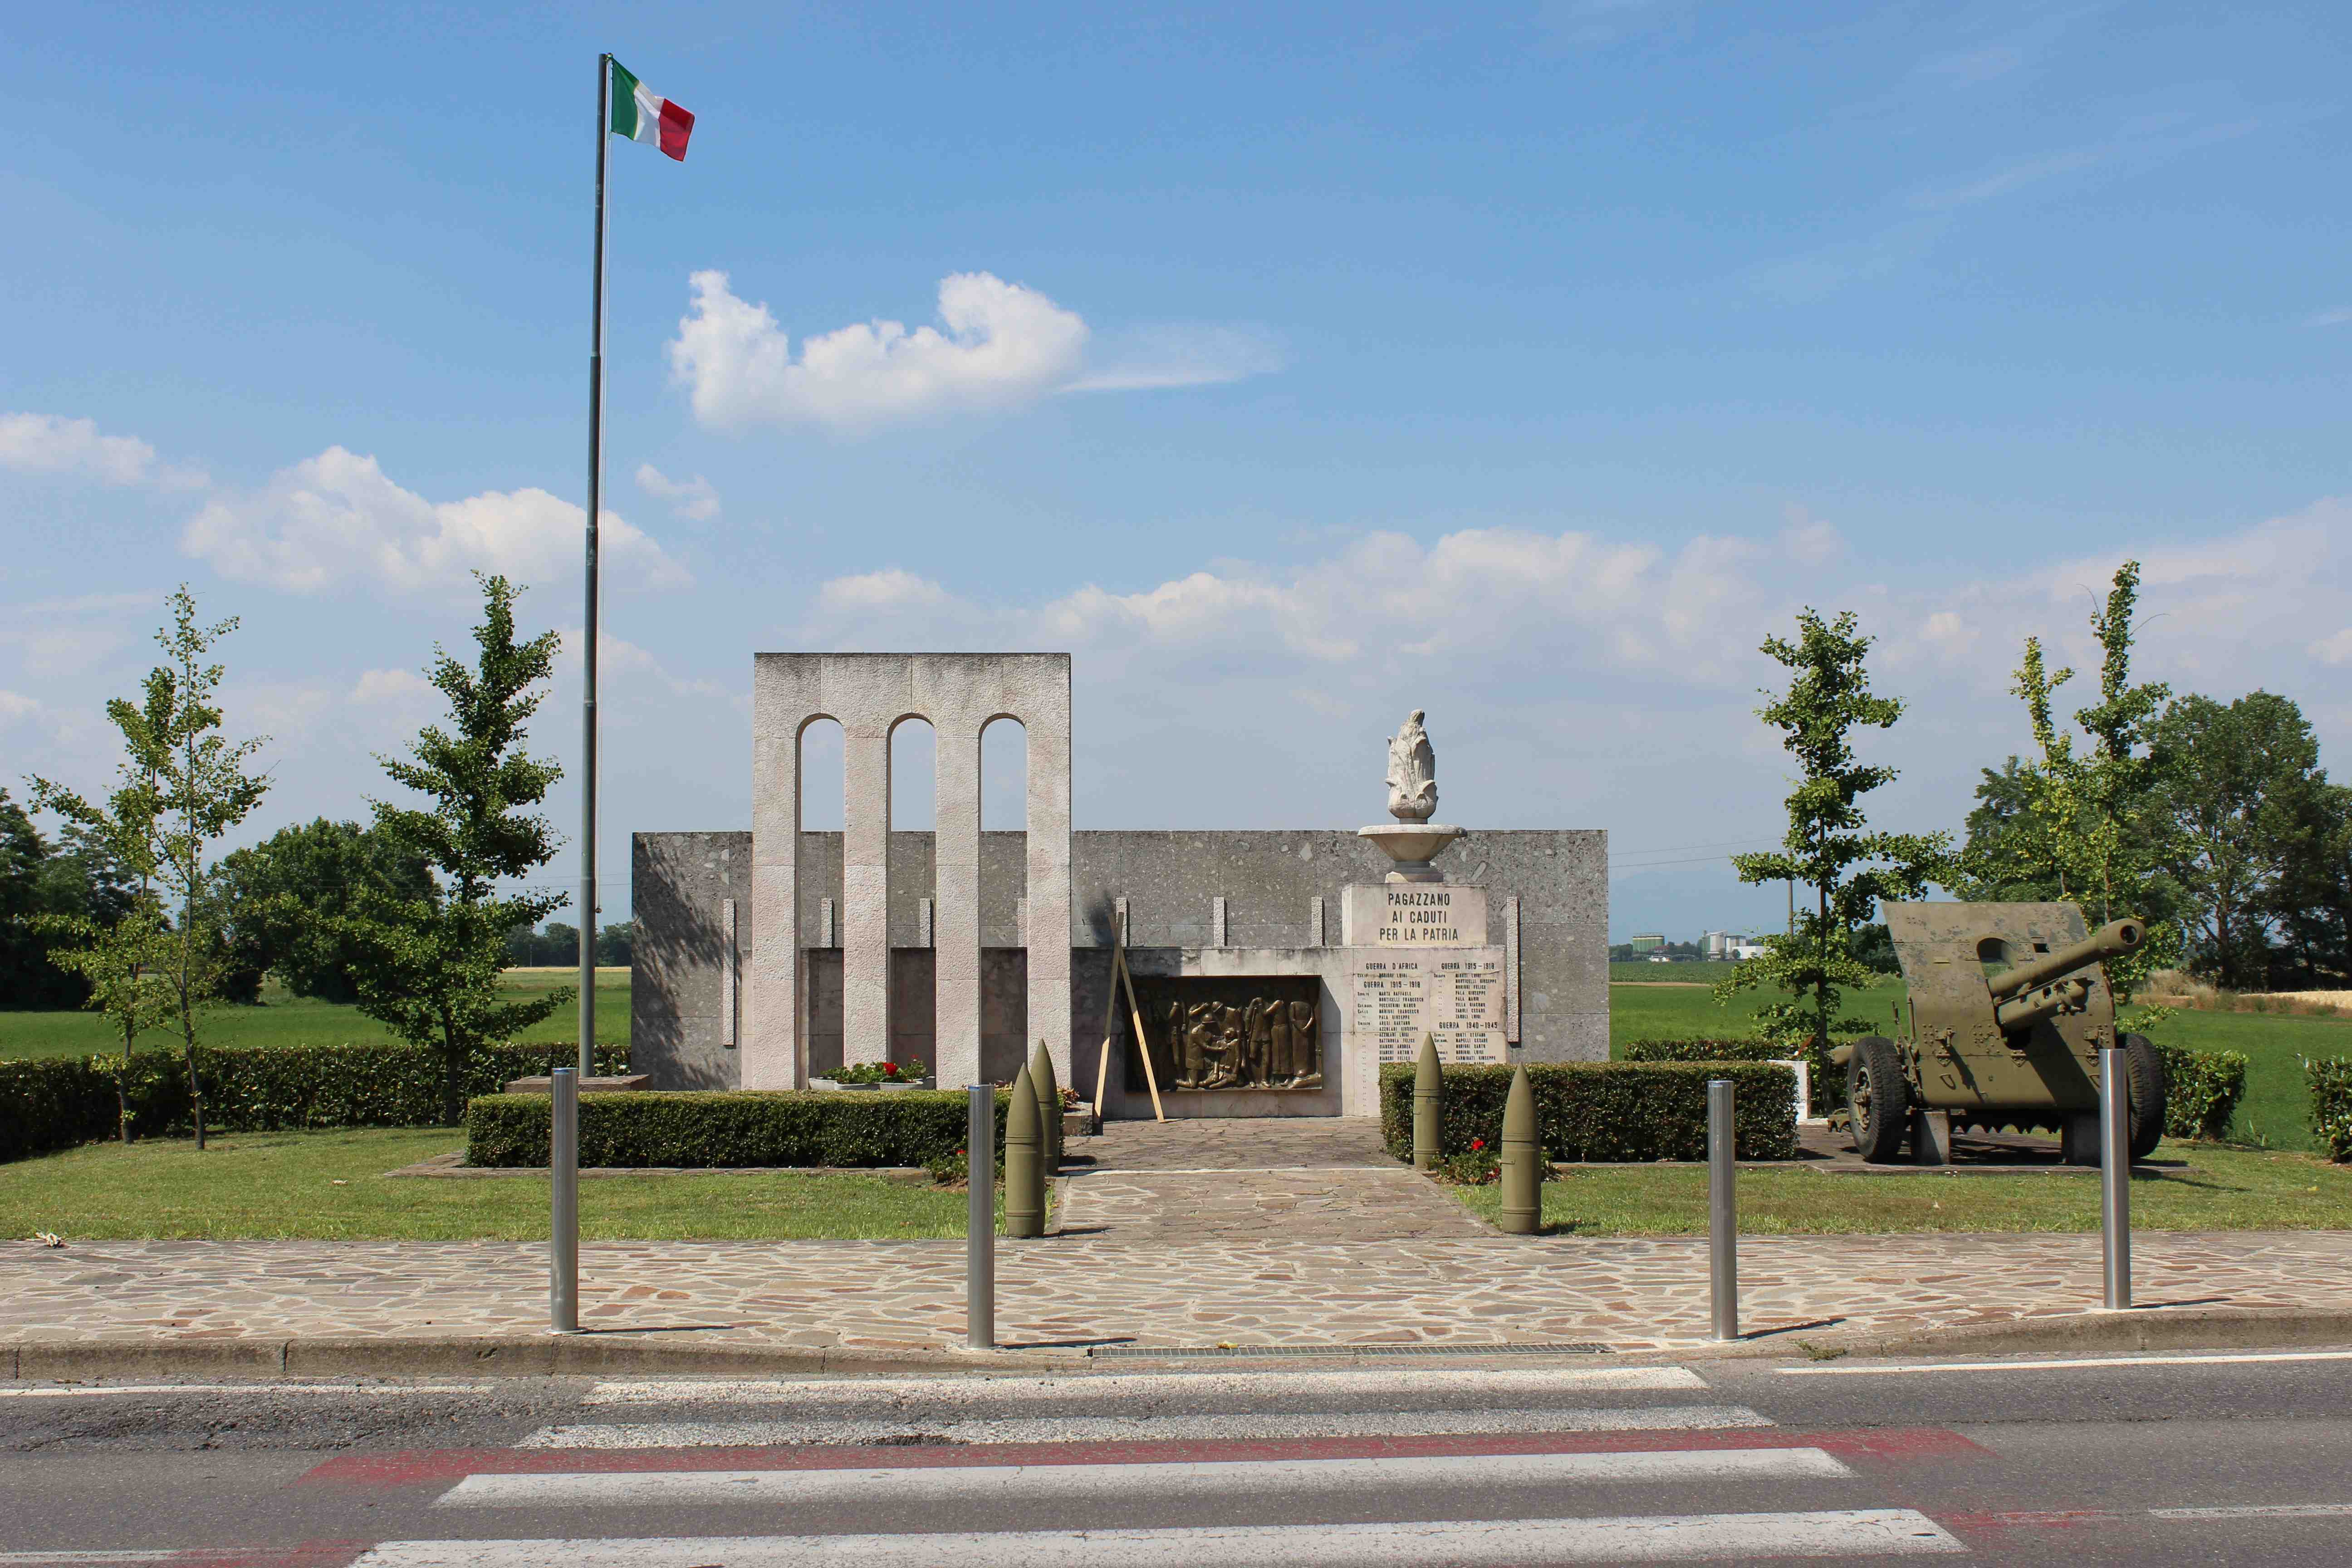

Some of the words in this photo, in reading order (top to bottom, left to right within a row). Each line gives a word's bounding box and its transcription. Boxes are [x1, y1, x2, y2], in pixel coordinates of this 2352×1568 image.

[1388, 893, 1450, 906] PAGAZZANO
[1392, 911, 1402, 923] AI
[1410, 911, 1447, 923] CADUTI
[1380, 928, 1398, 941] PER
[1404, 928, 1416, 941] LA
[1423, 928, 1459, 941] PATRIA
